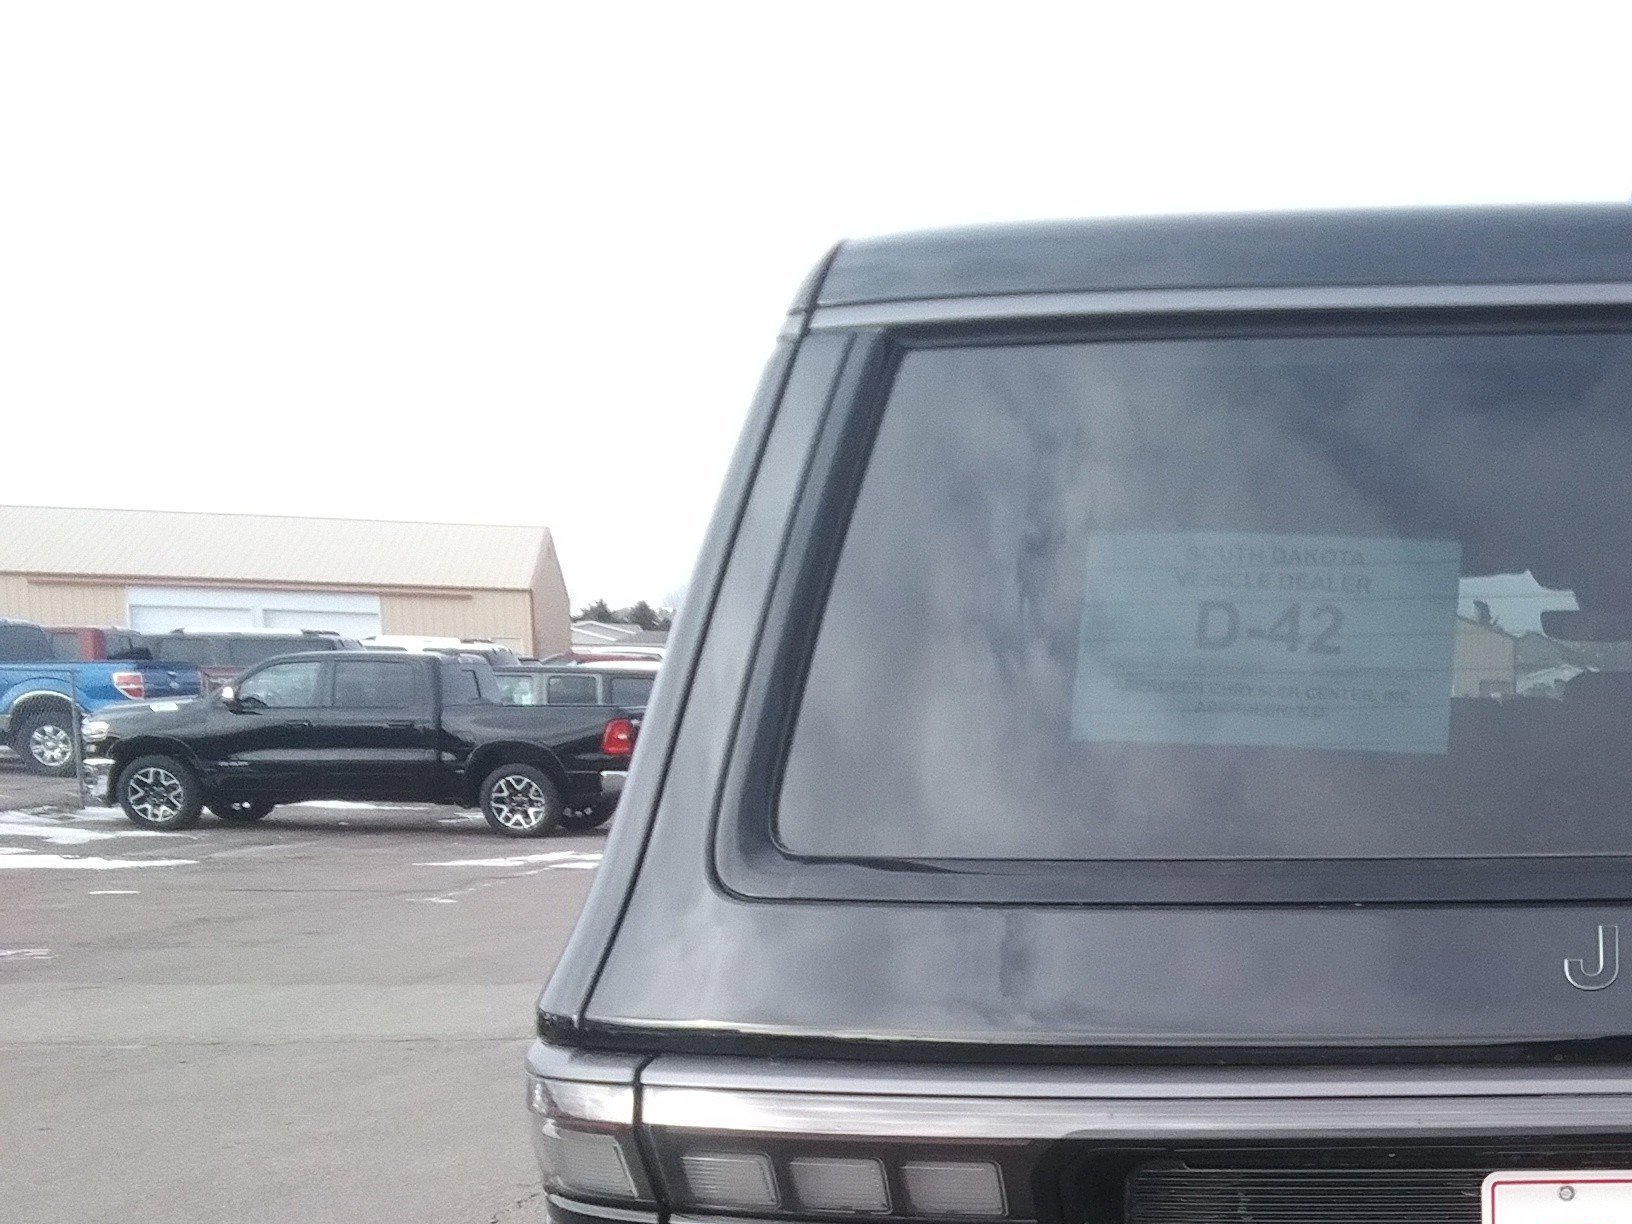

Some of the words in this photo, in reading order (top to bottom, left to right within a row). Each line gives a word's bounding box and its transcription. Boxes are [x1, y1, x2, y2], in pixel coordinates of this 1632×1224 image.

[1272, 545, 1366, 568] DAKOTA
[1279, 571, 1373, 595] DEALER
[1194, 599, 1346, 656] D-42
